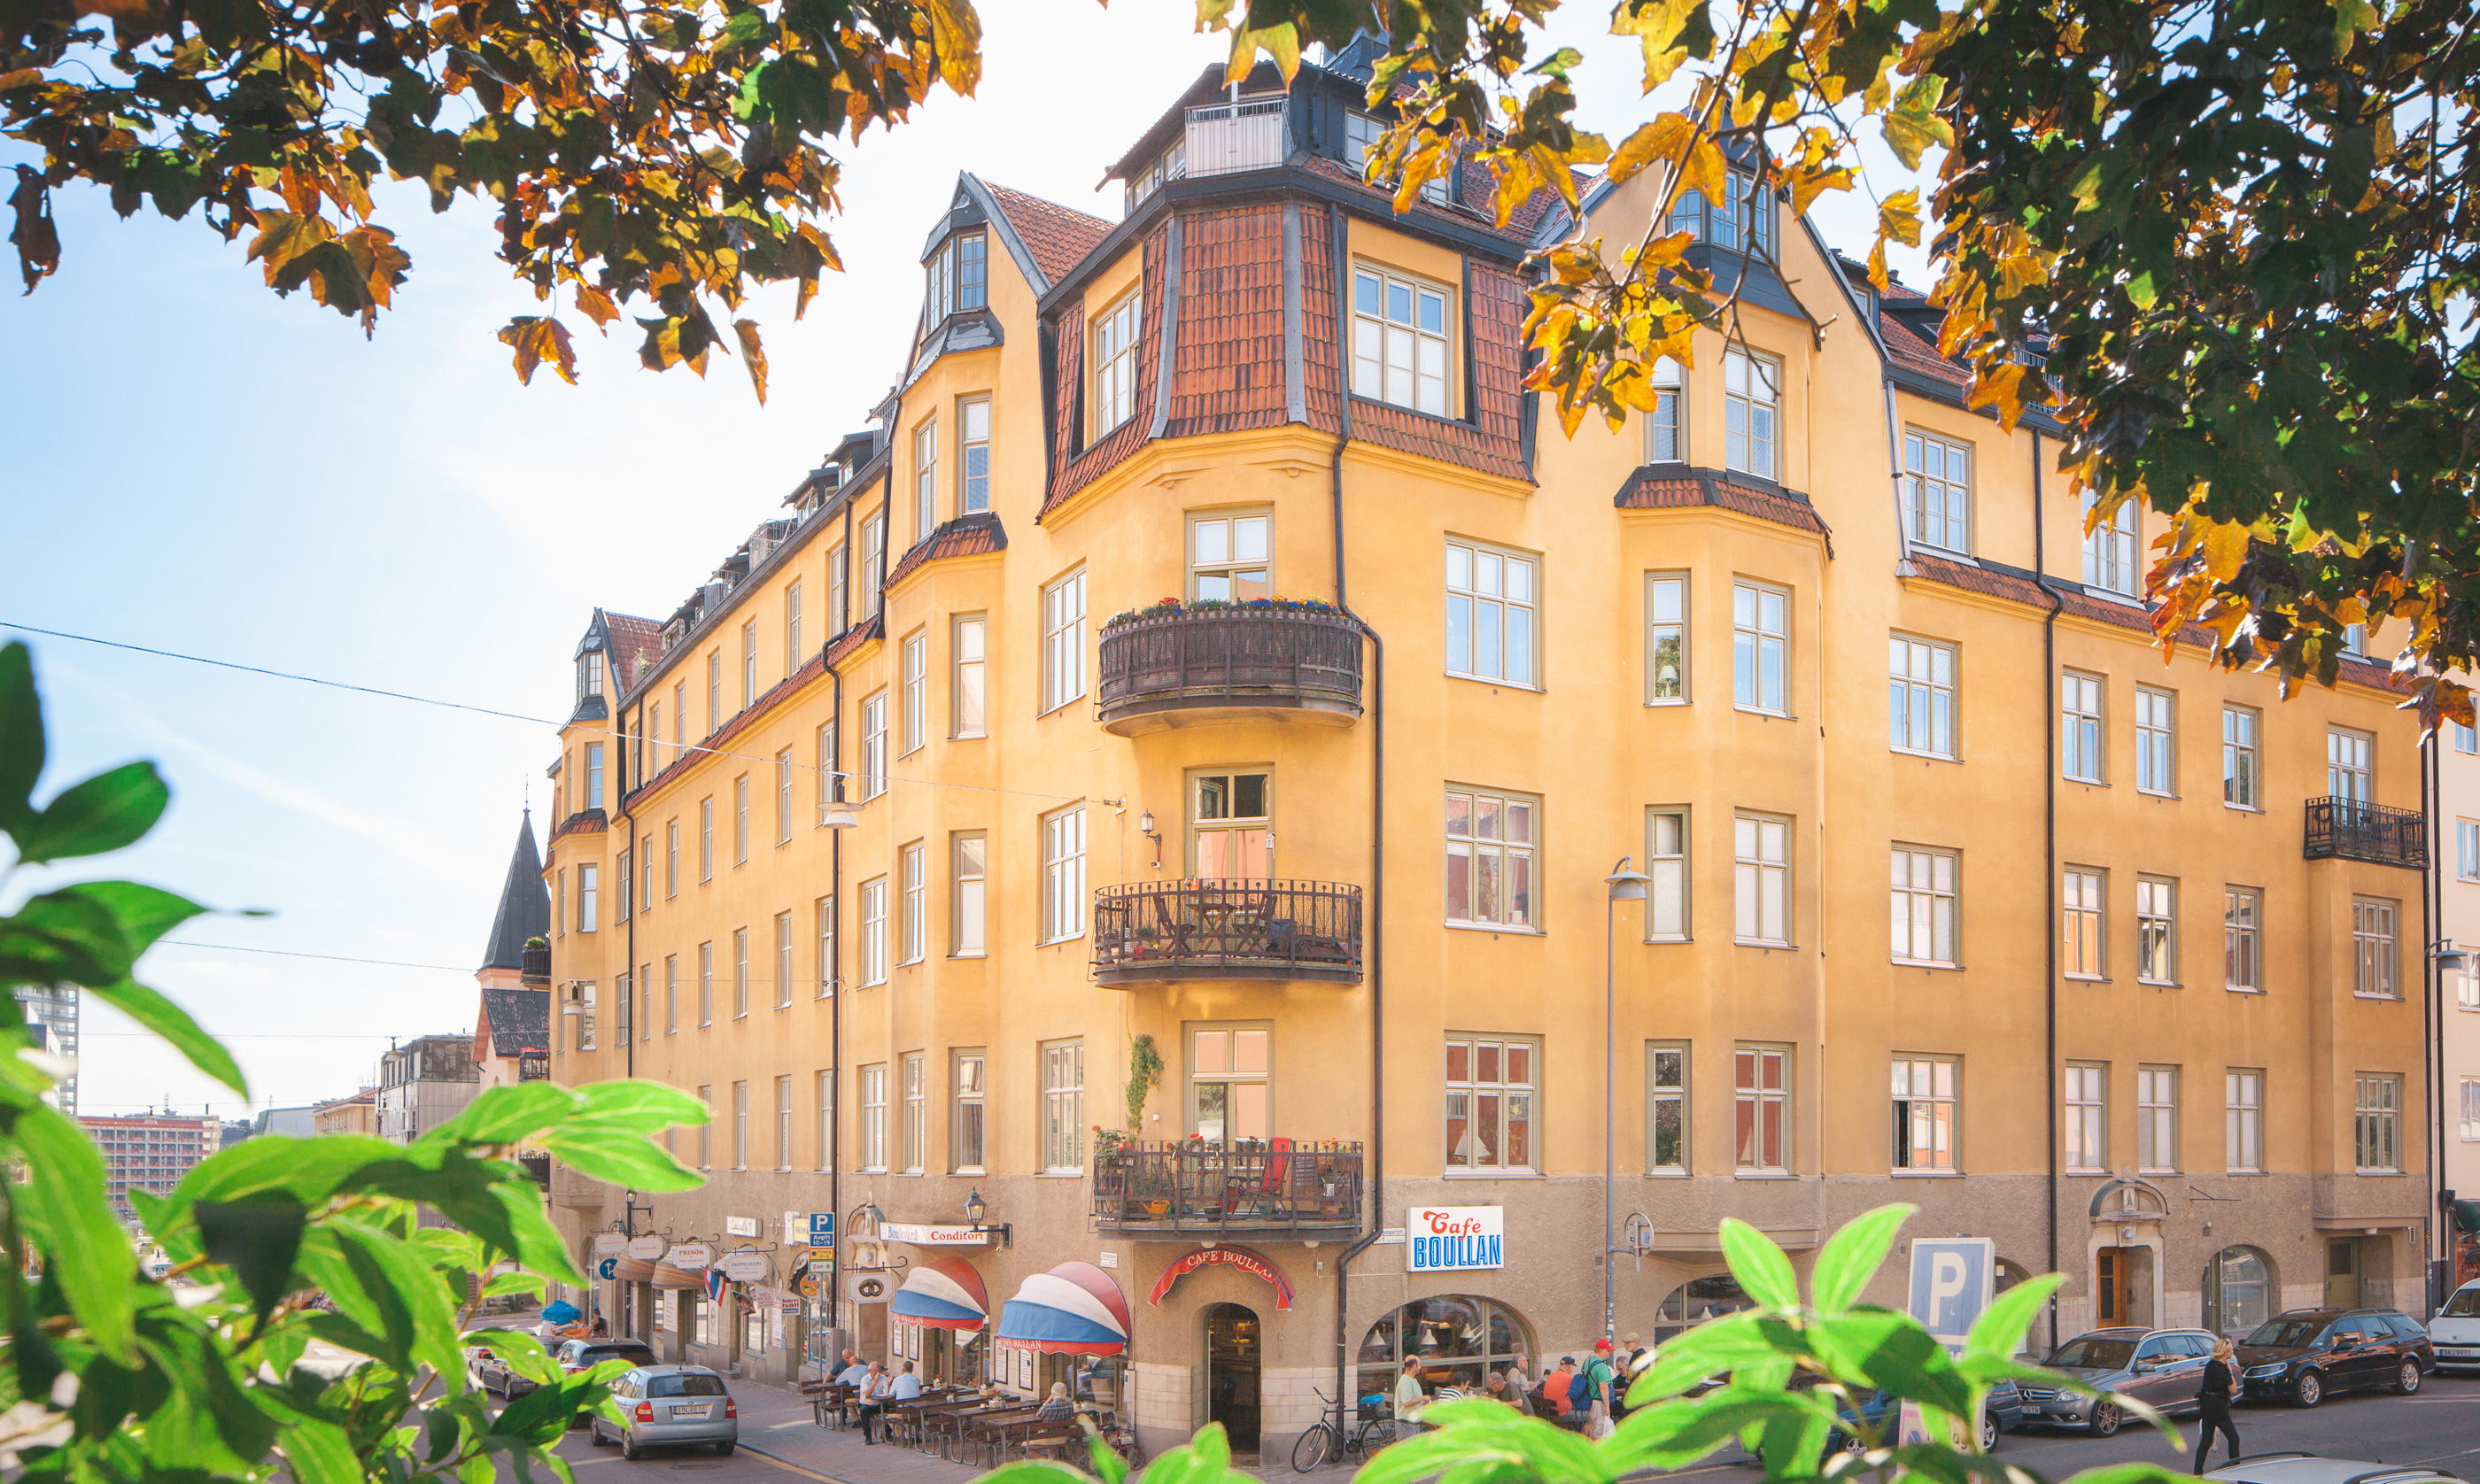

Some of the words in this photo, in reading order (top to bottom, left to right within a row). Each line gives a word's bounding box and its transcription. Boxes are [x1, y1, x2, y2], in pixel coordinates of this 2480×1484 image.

[816, 1215, 829, 1231] P
[887, 1225, 918, 1241] Boulevard
[930, 1231, 983, 1241] Conditori
[1422, 1210, 1482, 1241] Café
[1223, 1250, 1276, 1280] BOULLA
[1414, 1234, 1501, 1268] BOULLAN
[1928, 1251, 1967, 1327] P
